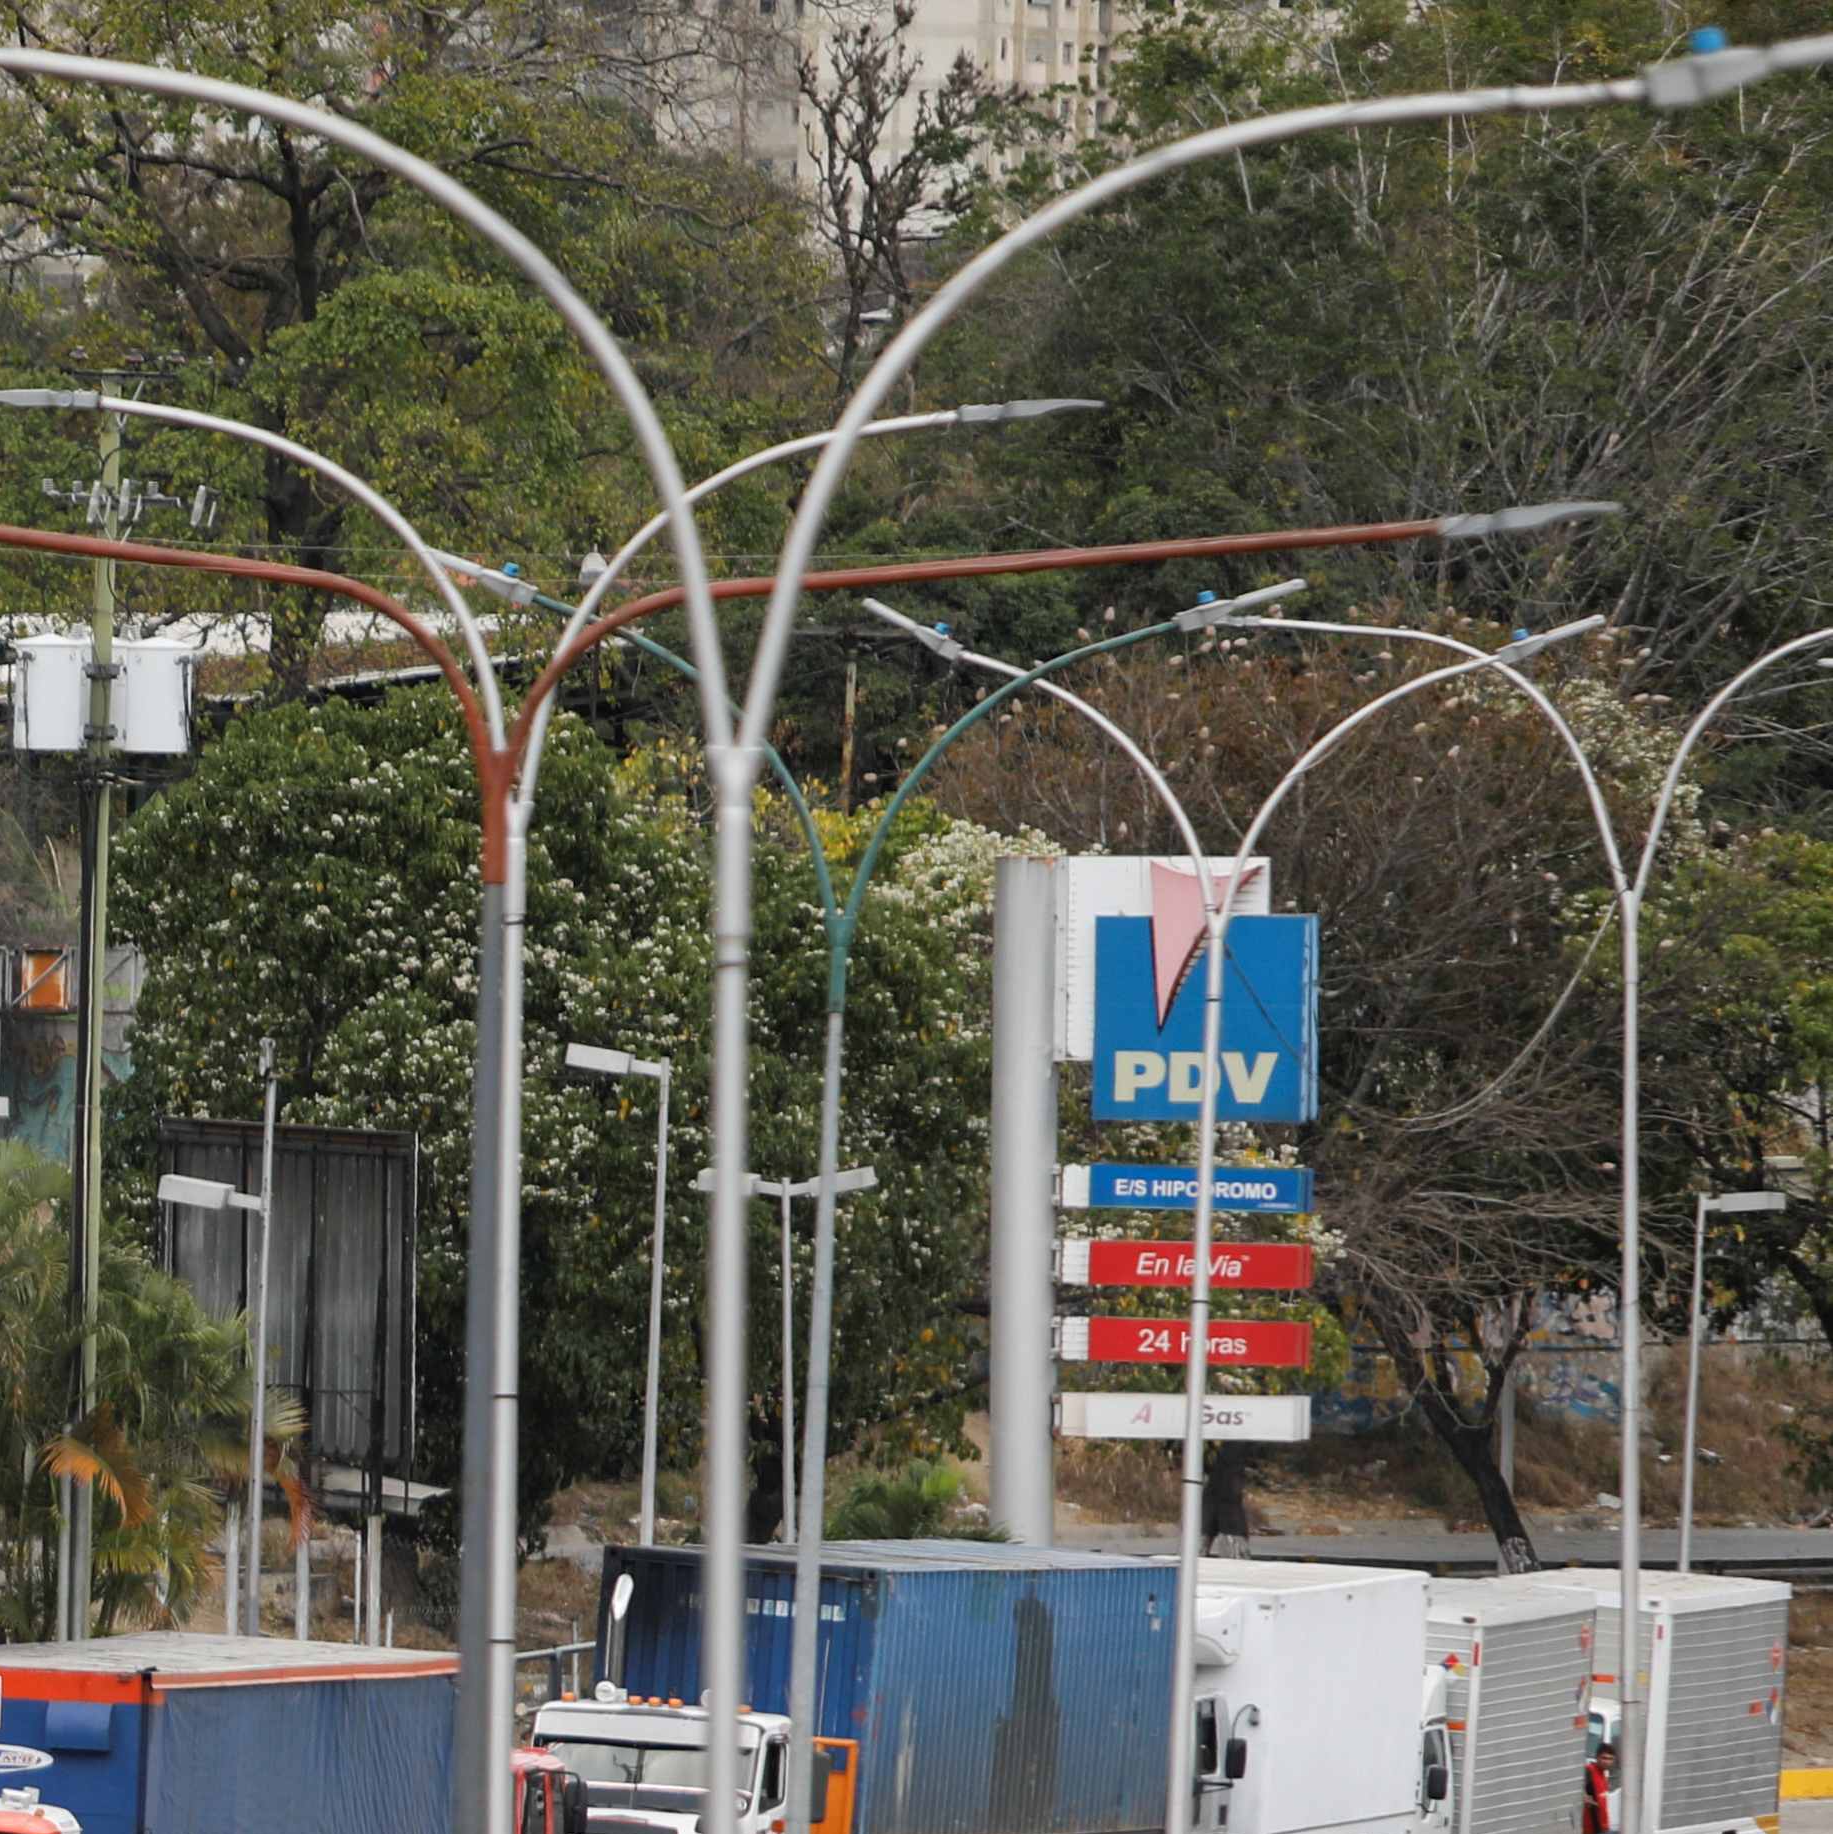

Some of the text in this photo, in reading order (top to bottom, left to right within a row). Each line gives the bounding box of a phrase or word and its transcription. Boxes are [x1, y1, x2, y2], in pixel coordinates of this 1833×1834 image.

[1115, 1051, 1279, 1104] PDV
[1115, 1178, 1277, 1200] E/S HIPOROMO
[1136, 1252, 1170, 1276] En
[1138, 1329, 1171, 1353] 24
